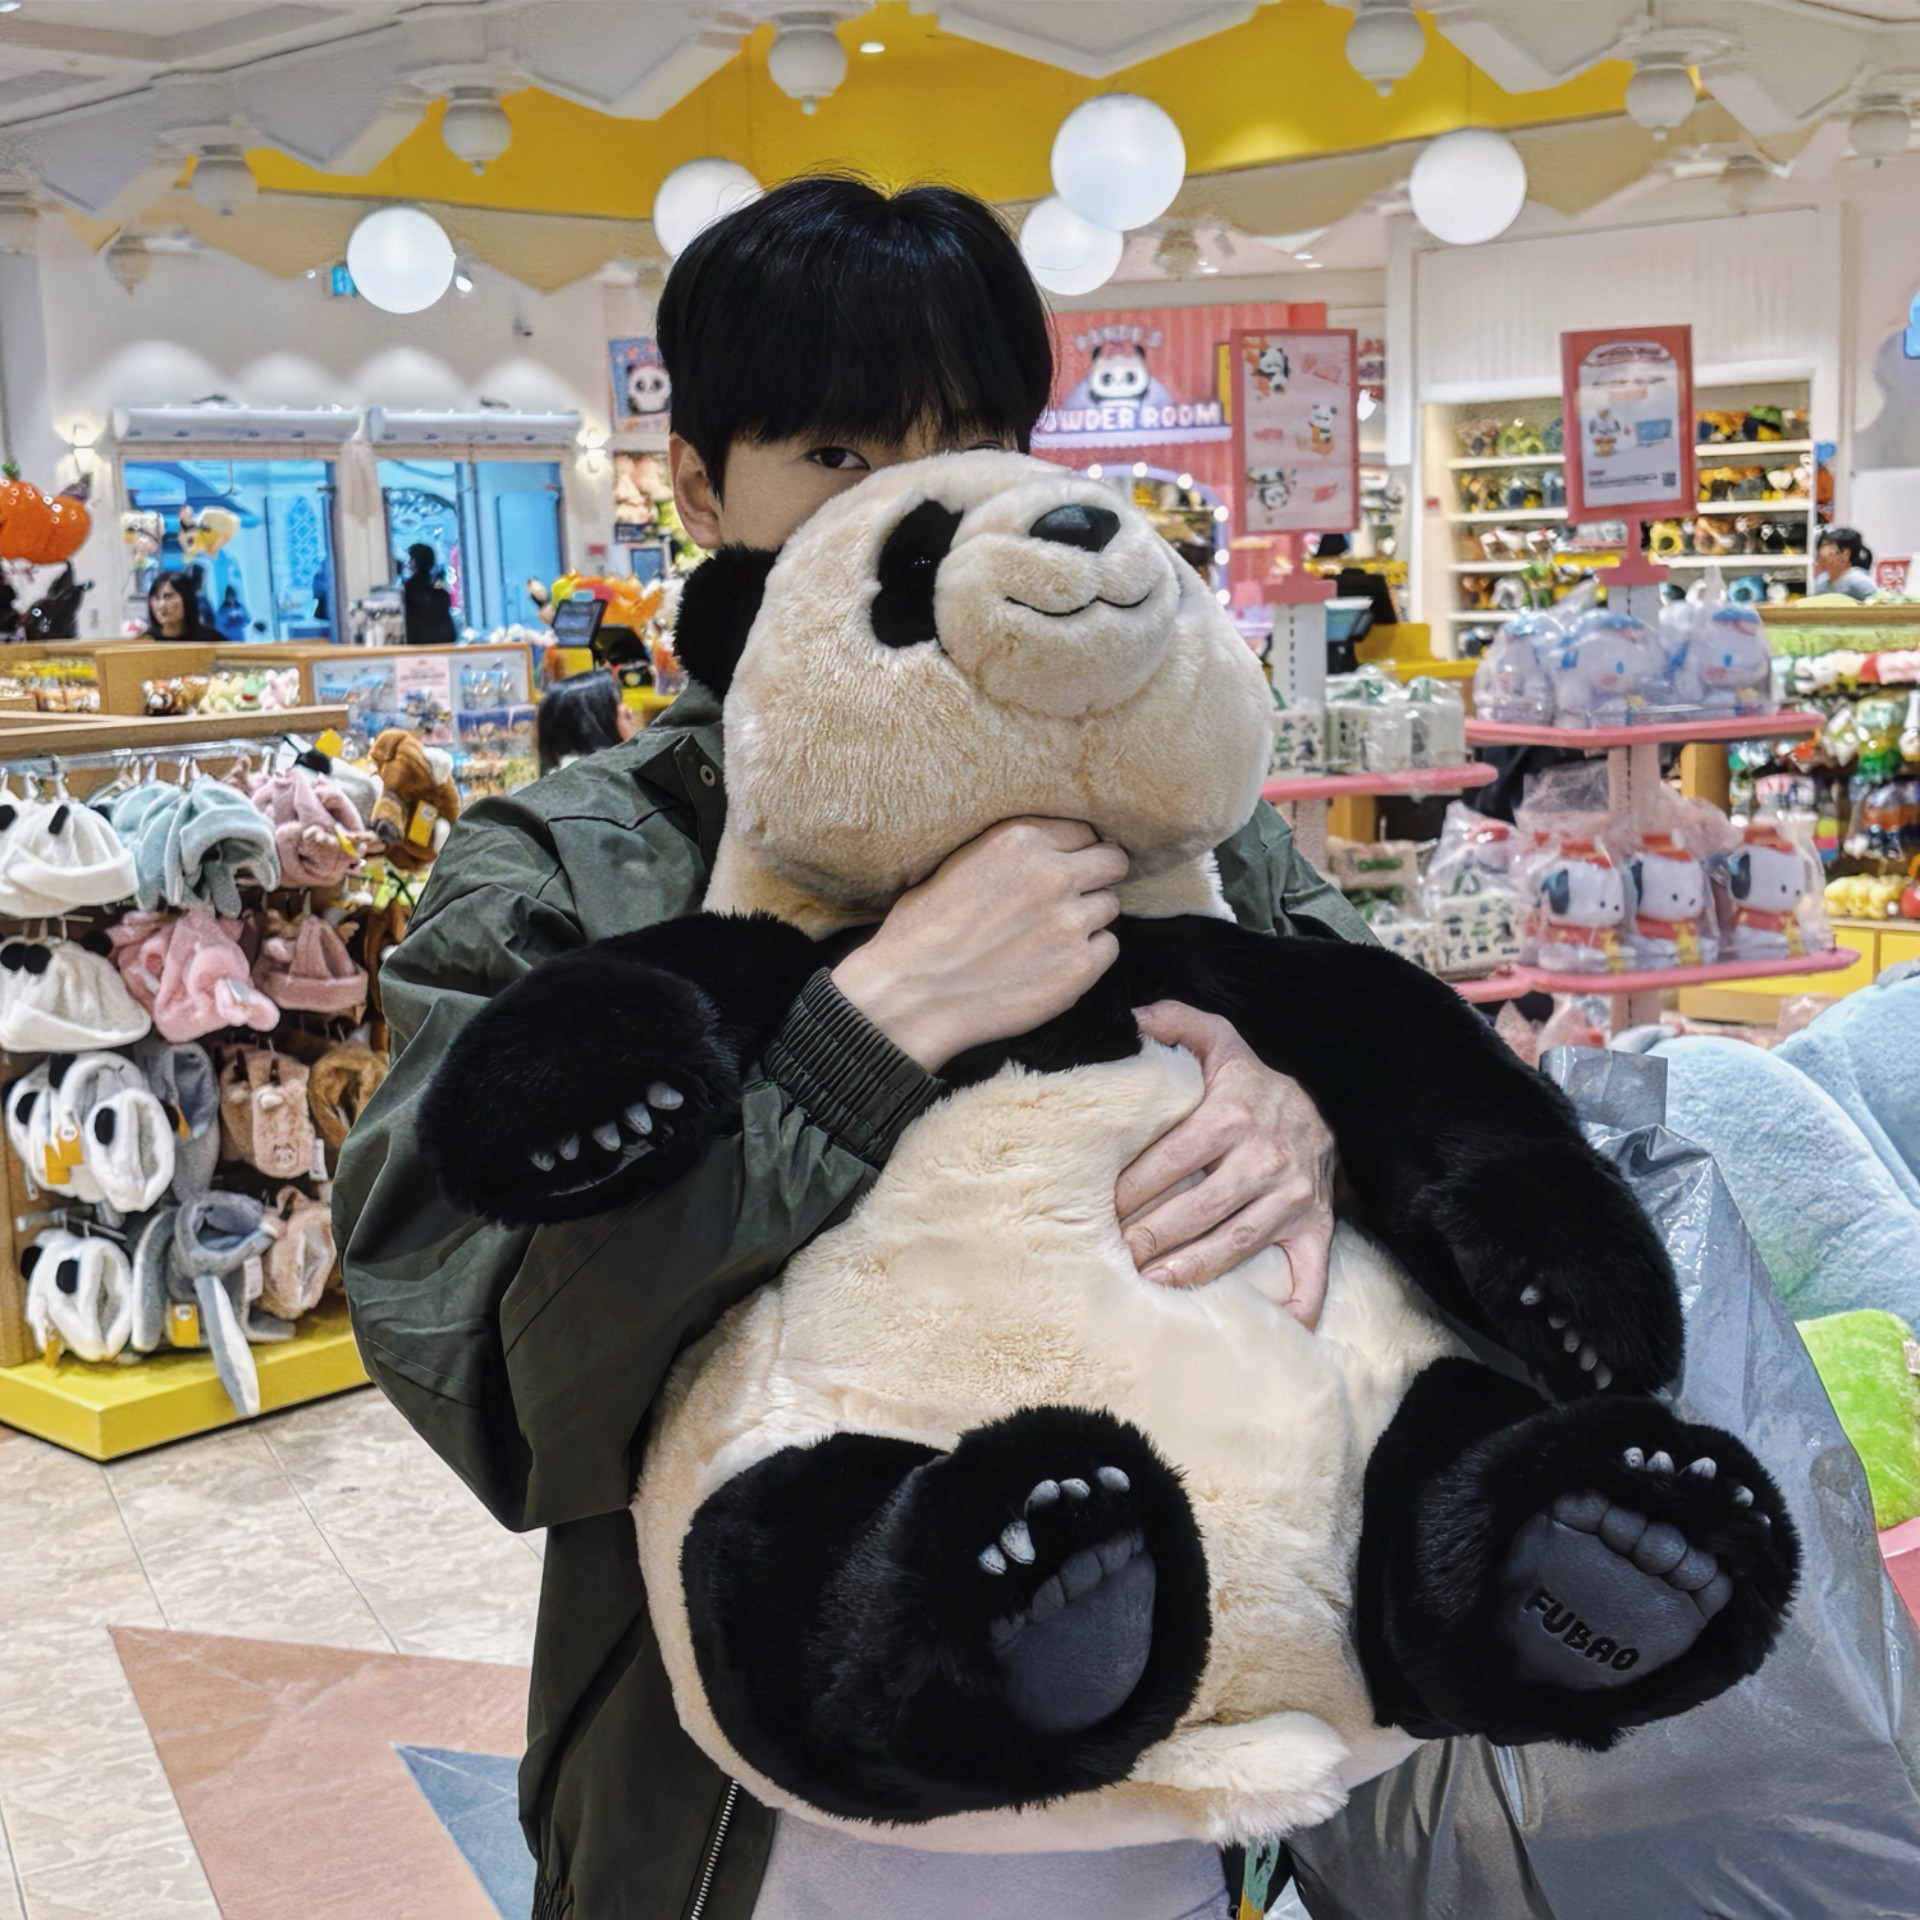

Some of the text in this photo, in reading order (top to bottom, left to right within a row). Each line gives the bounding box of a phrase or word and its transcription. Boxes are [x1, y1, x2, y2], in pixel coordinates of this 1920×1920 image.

[1041, 401, 1221, 432] OWDER ROOM
[1523, 1586, 1640, 1671] FUBAO
